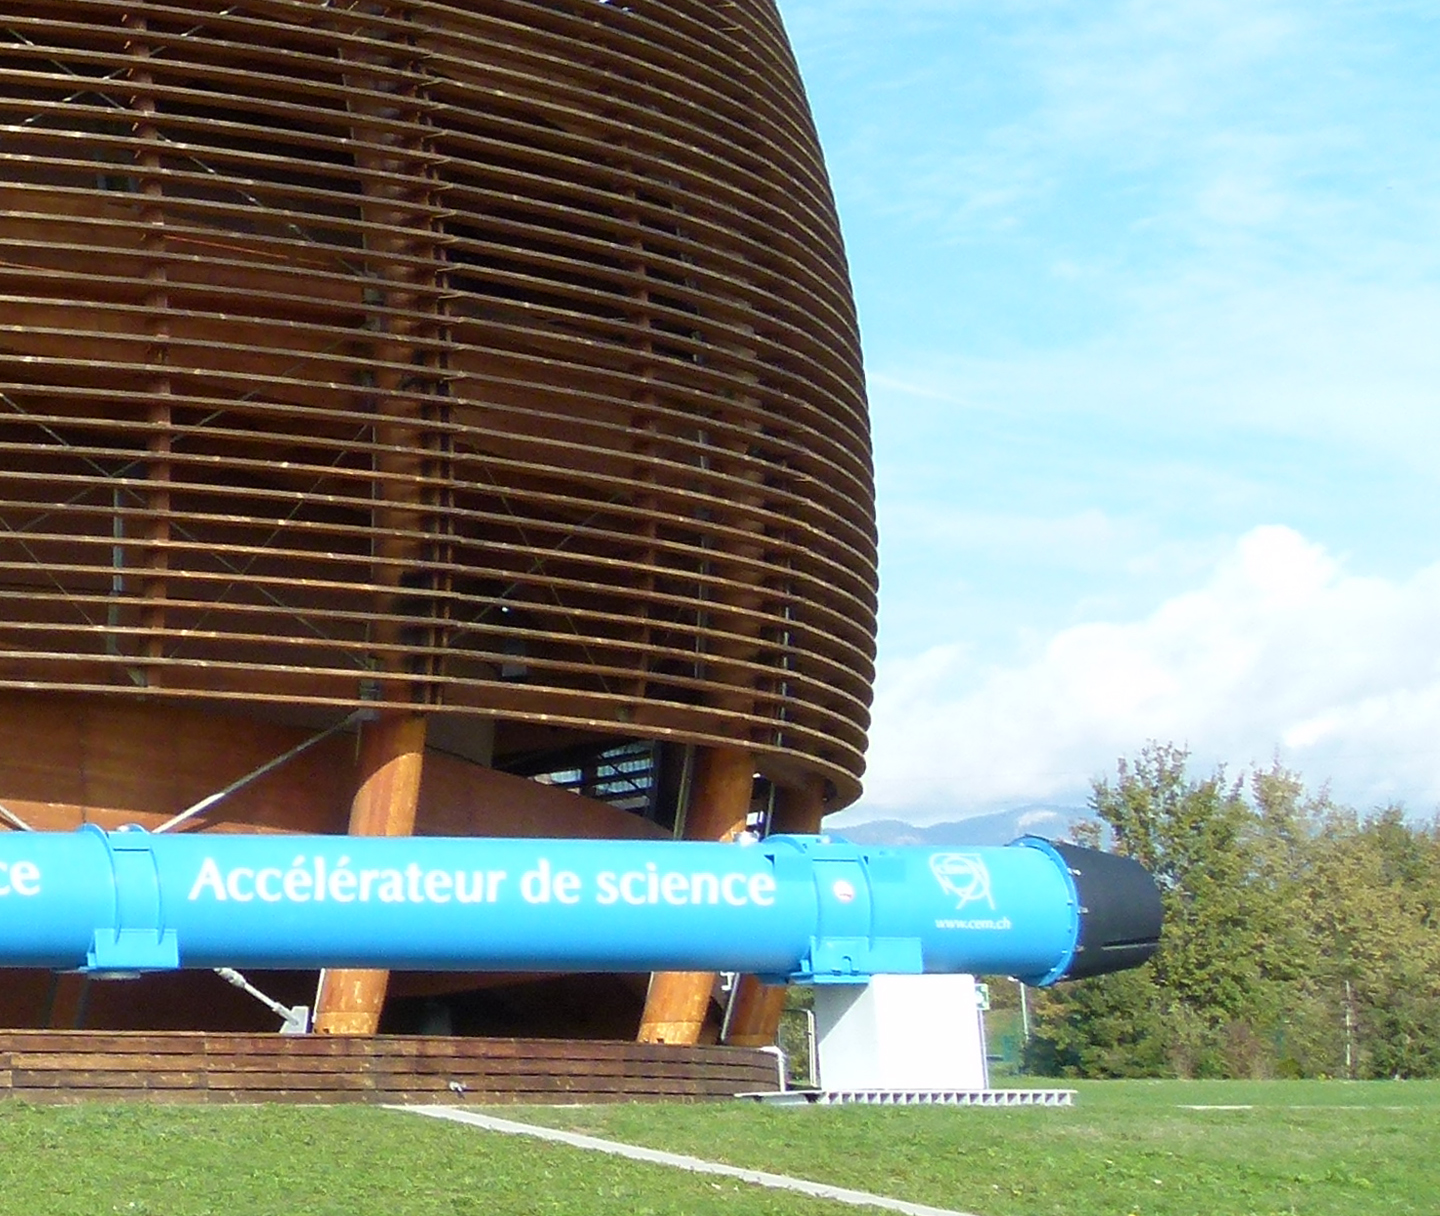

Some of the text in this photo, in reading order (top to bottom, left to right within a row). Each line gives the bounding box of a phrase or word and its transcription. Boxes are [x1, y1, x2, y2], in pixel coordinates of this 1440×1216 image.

[188, 855, 776, 906] Accélérateur de science
[934, 916, 1012, 930] www.cern.ch
